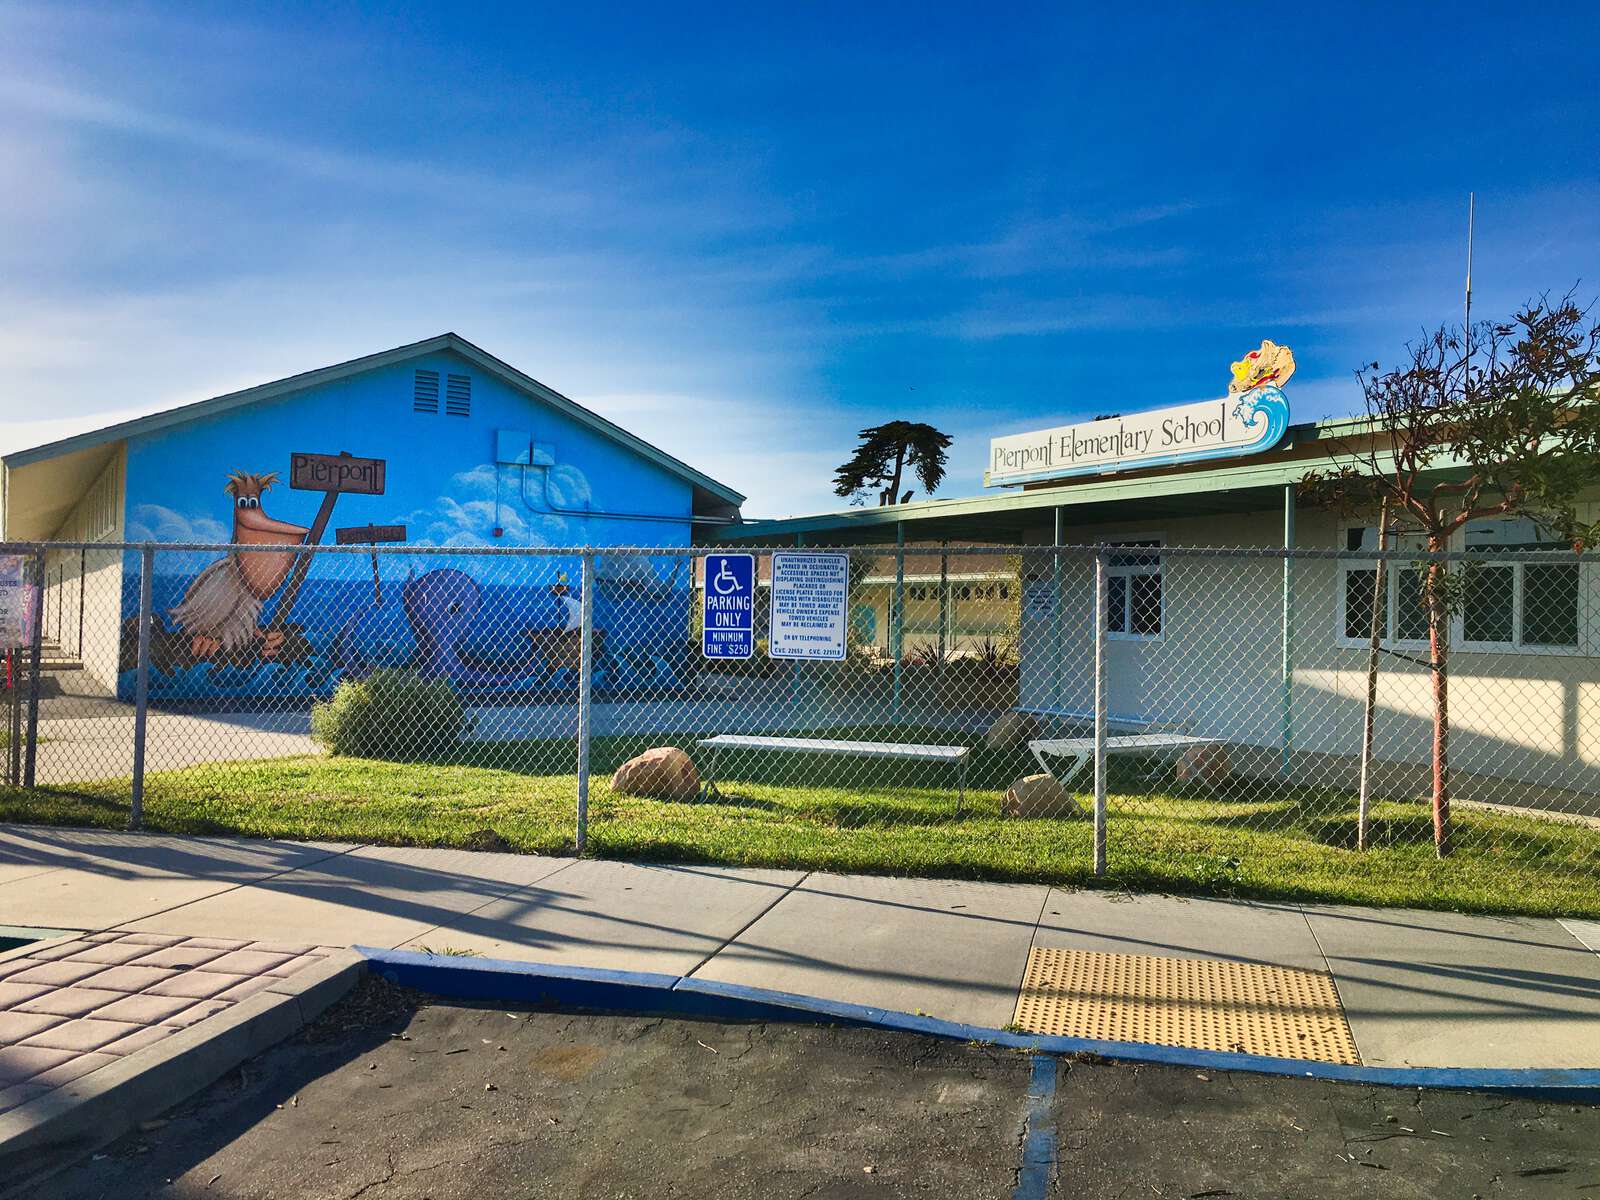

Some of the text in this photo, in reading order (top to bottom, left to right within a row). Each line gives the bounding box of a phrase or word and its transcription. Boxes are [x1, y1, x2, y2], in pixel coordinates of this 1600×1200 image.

[994, 403, 1226, 472] Pierpont Elementary School
[294, 456, 381, 491] Pierpont
[707, 596, 750, 610] PARKING
[716, 612, 741, 627] ONLY
[712, 632, 743, 642] MINIMUM
[707, 644, 748, 654] FINE $250
